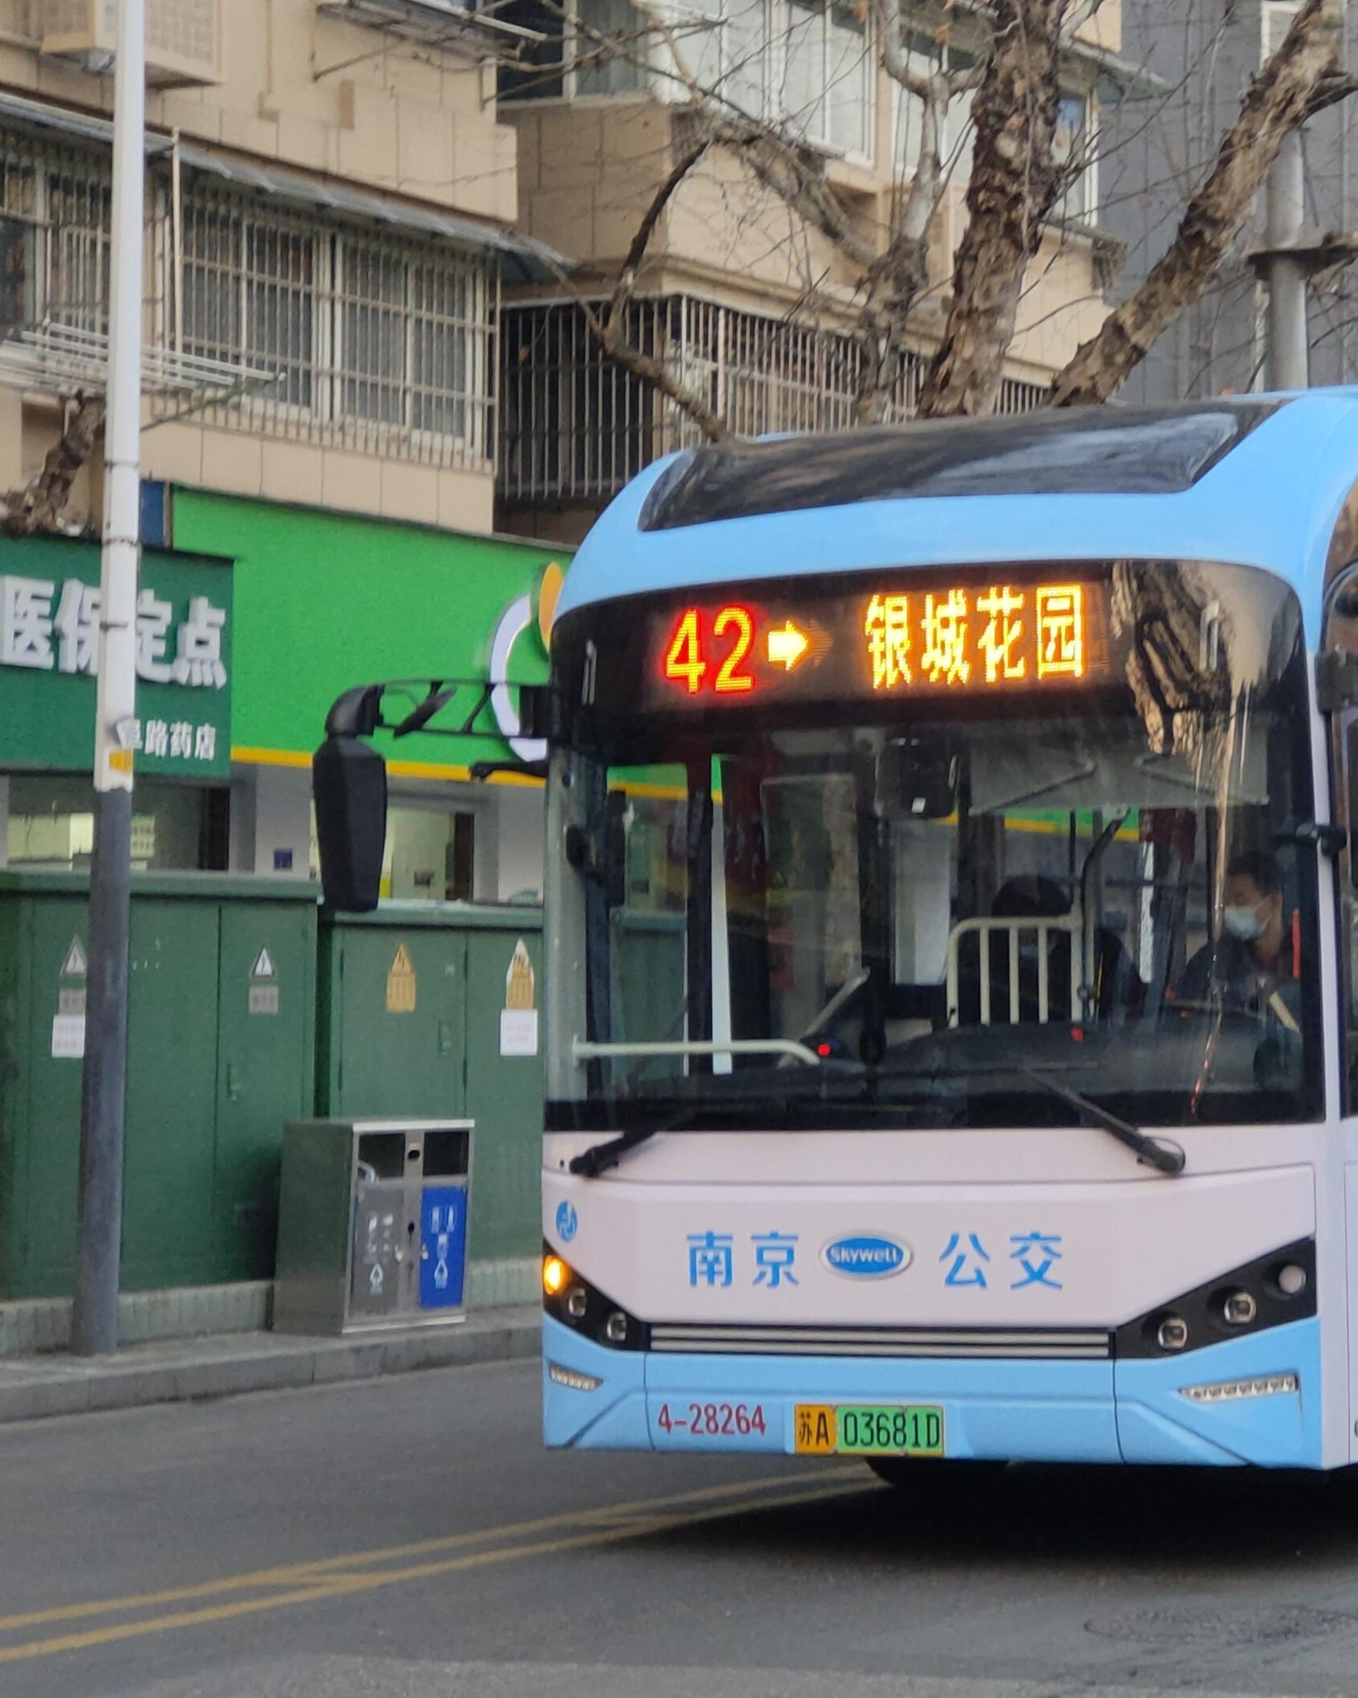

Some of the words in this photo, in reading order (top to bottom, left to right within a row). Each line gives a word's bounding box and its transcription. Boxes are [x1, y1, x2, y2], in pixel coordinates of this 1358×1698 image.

[0, 575, 227, 690] 医保定点
[666, 606, 754, 693] 42
[864, 584, 1083, 690] 银城花园
[686, 1230, 800, 1289] 南京
[939, 1231, 1063, 1290] 公交
[658, 1402, 767, 1435] 4-28264
